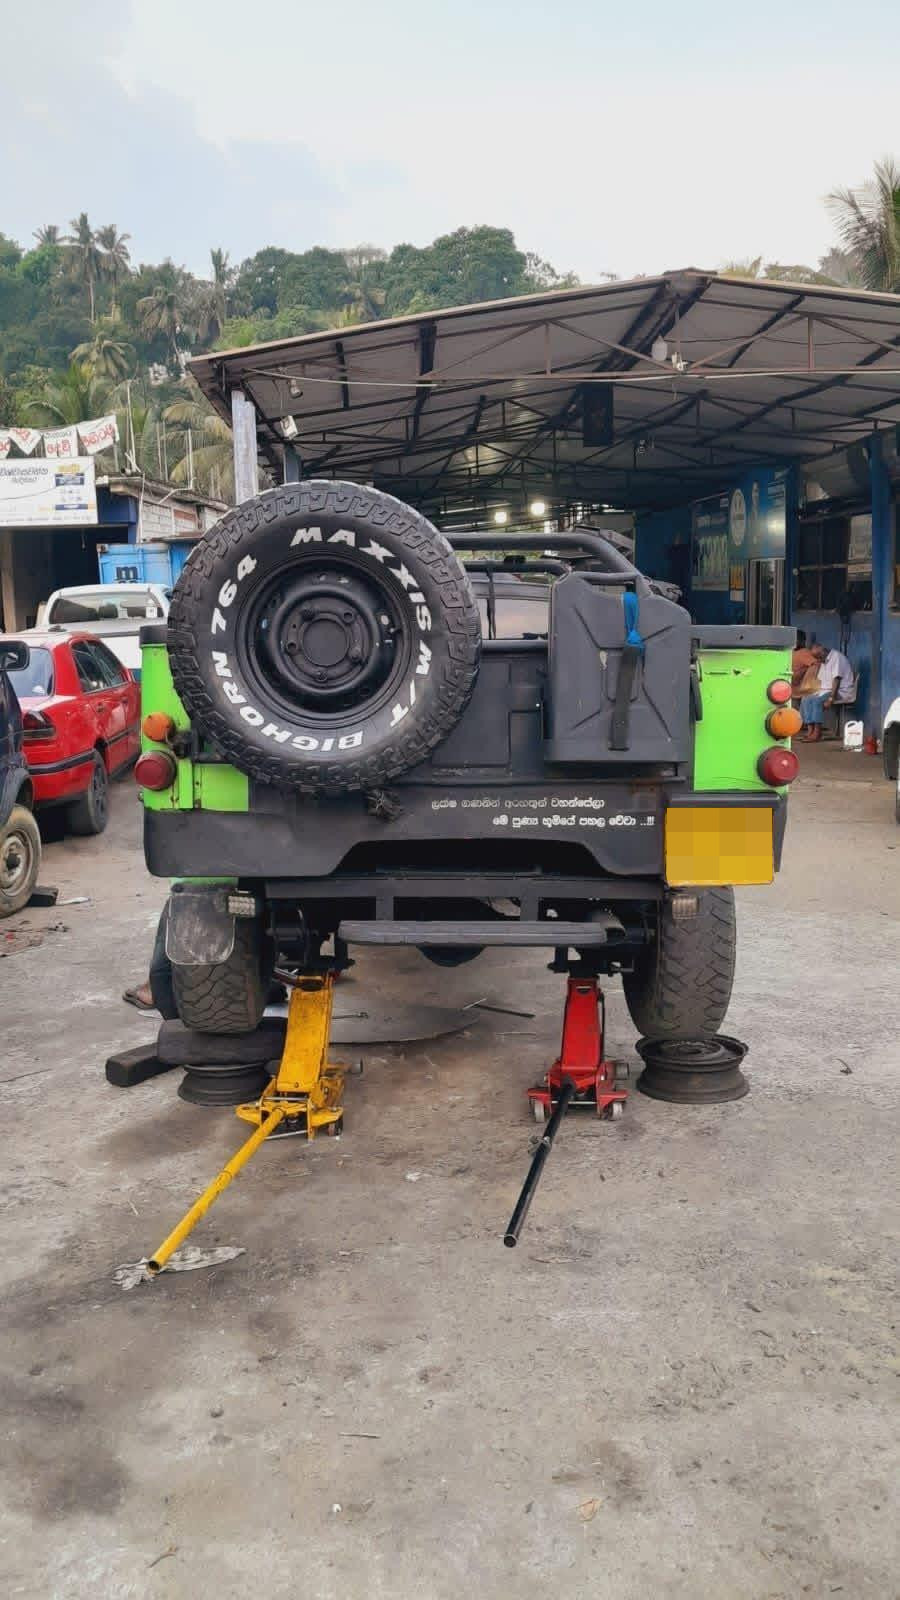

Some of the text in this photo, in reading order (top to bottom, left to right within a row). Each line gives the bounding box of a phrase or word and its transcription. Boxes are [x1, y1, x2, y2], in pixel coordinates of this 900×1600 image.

[211, 553, 364, 752] BIGHORN 764
[289, 526, 433, 729] MAXXIS M/T
